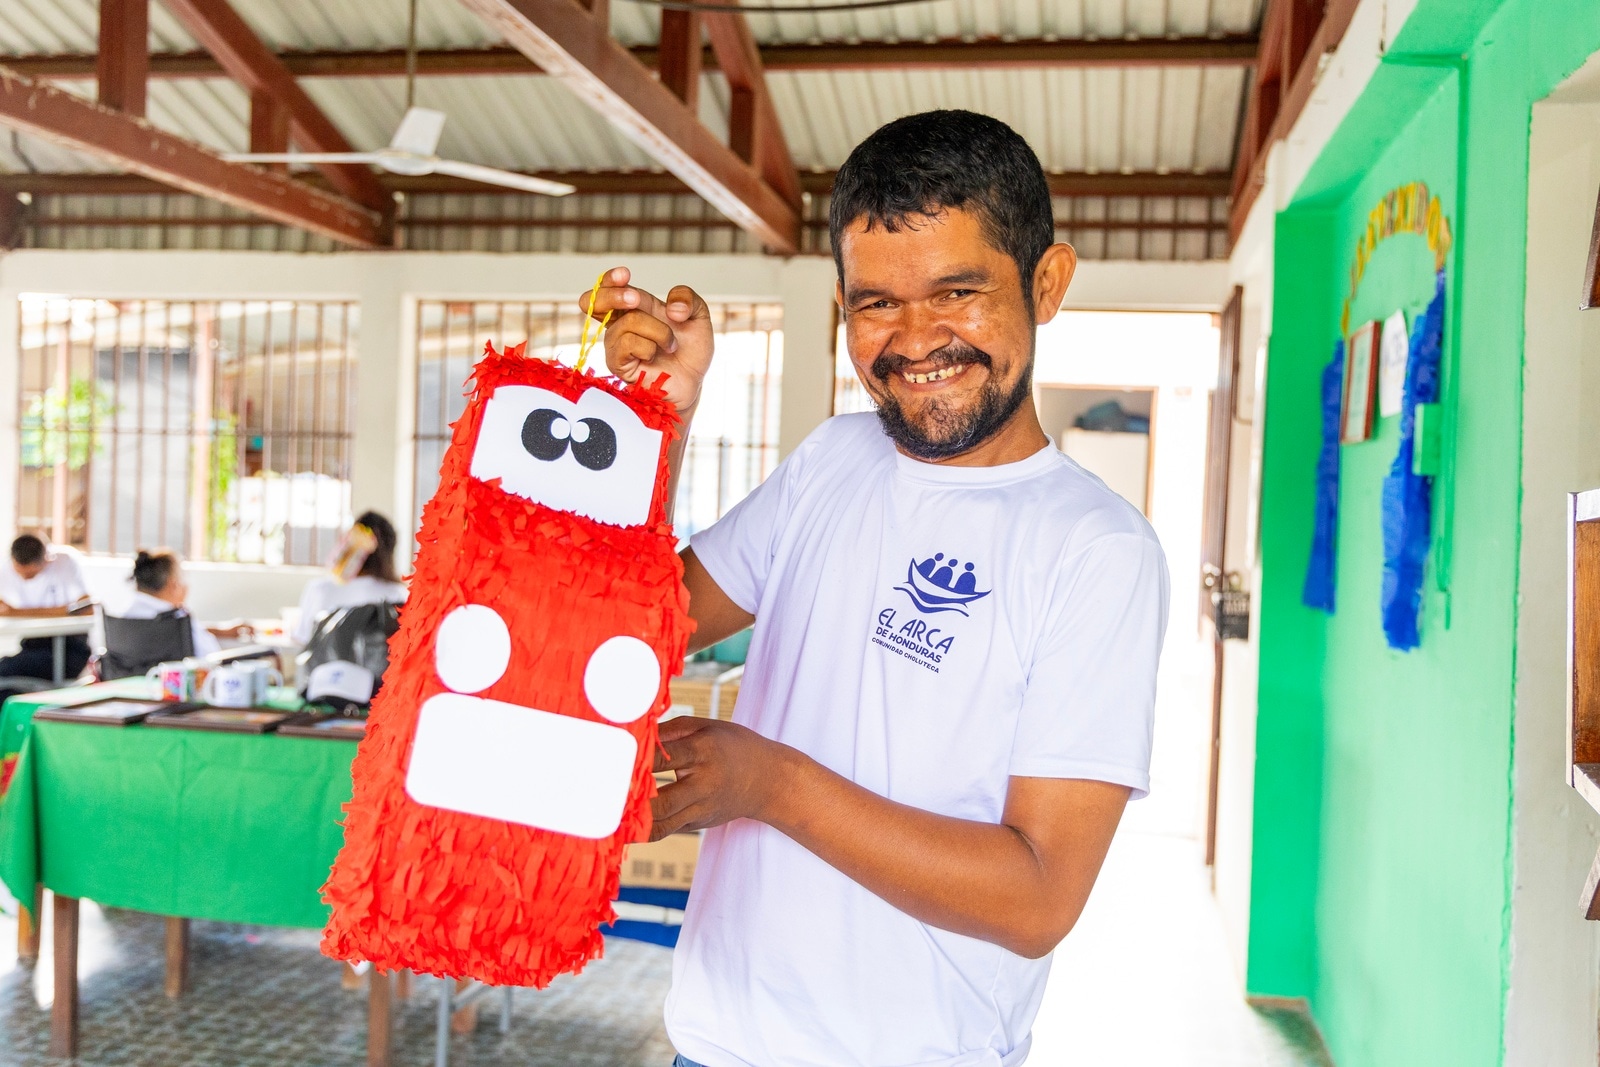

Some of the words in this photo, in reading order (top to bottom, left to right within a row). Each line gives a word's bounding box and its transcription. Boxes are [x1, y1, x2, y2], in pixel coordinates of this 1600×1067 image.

[875, 626, 890, 638] DE
[888, 632, 943, 664] HONDURAS
[878, 608, 897, 629] EL
[899, 618, 955, 655] ARCA
[871, 637, 904, 656] COMUNIDAD
[903, 652, 940, 674] CHOLUTECA
